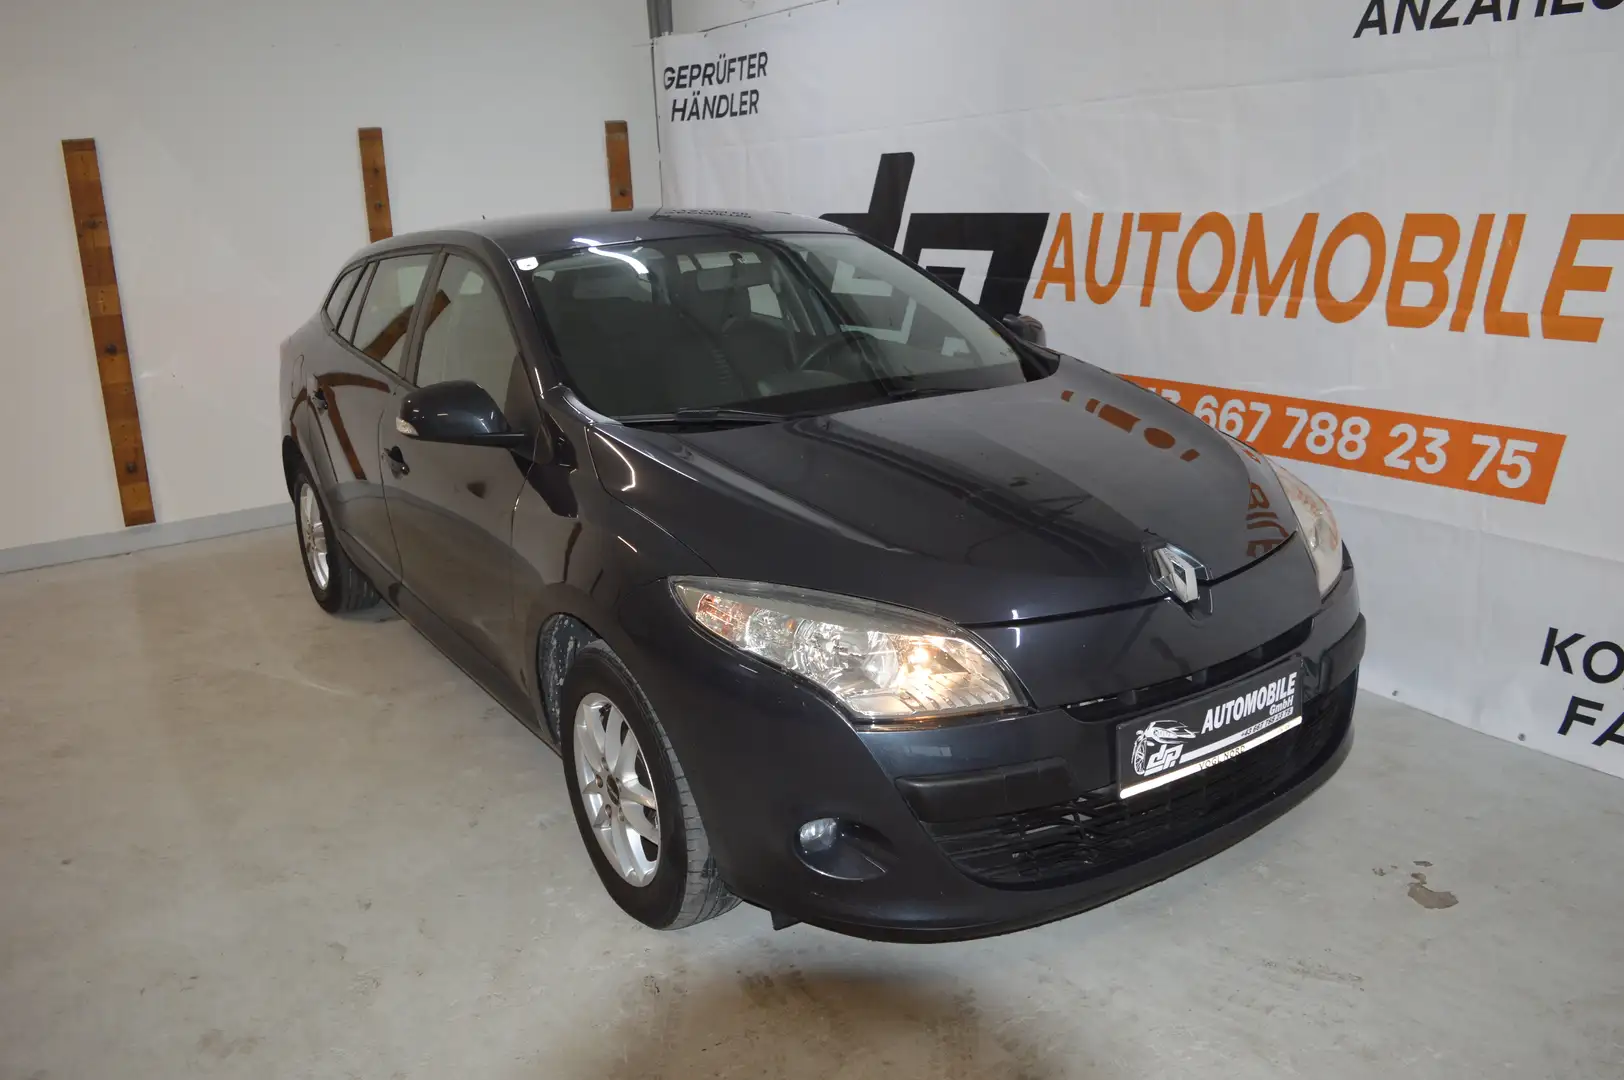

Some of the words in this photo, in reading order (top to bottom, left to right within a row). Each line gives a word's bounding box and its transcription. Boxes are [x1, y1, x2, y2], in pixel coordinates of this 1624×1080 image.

[663, 51, 768, 90] GEPRÜFTER
[671, 89, 760, 122] HÄNDLER
[1033, 211, 1624, 343] AUTOMOBILE
[1194, 395, 1271, 444] 667
[1282, 406, 1371, 461] 788
[1383, 423, 1450, 475] 23
[1467, 434, 1538, 489] 75
[1201, 671, 1297, 735] AUTOMOBILE
[1269, 694, 1294, 716] GmbH
